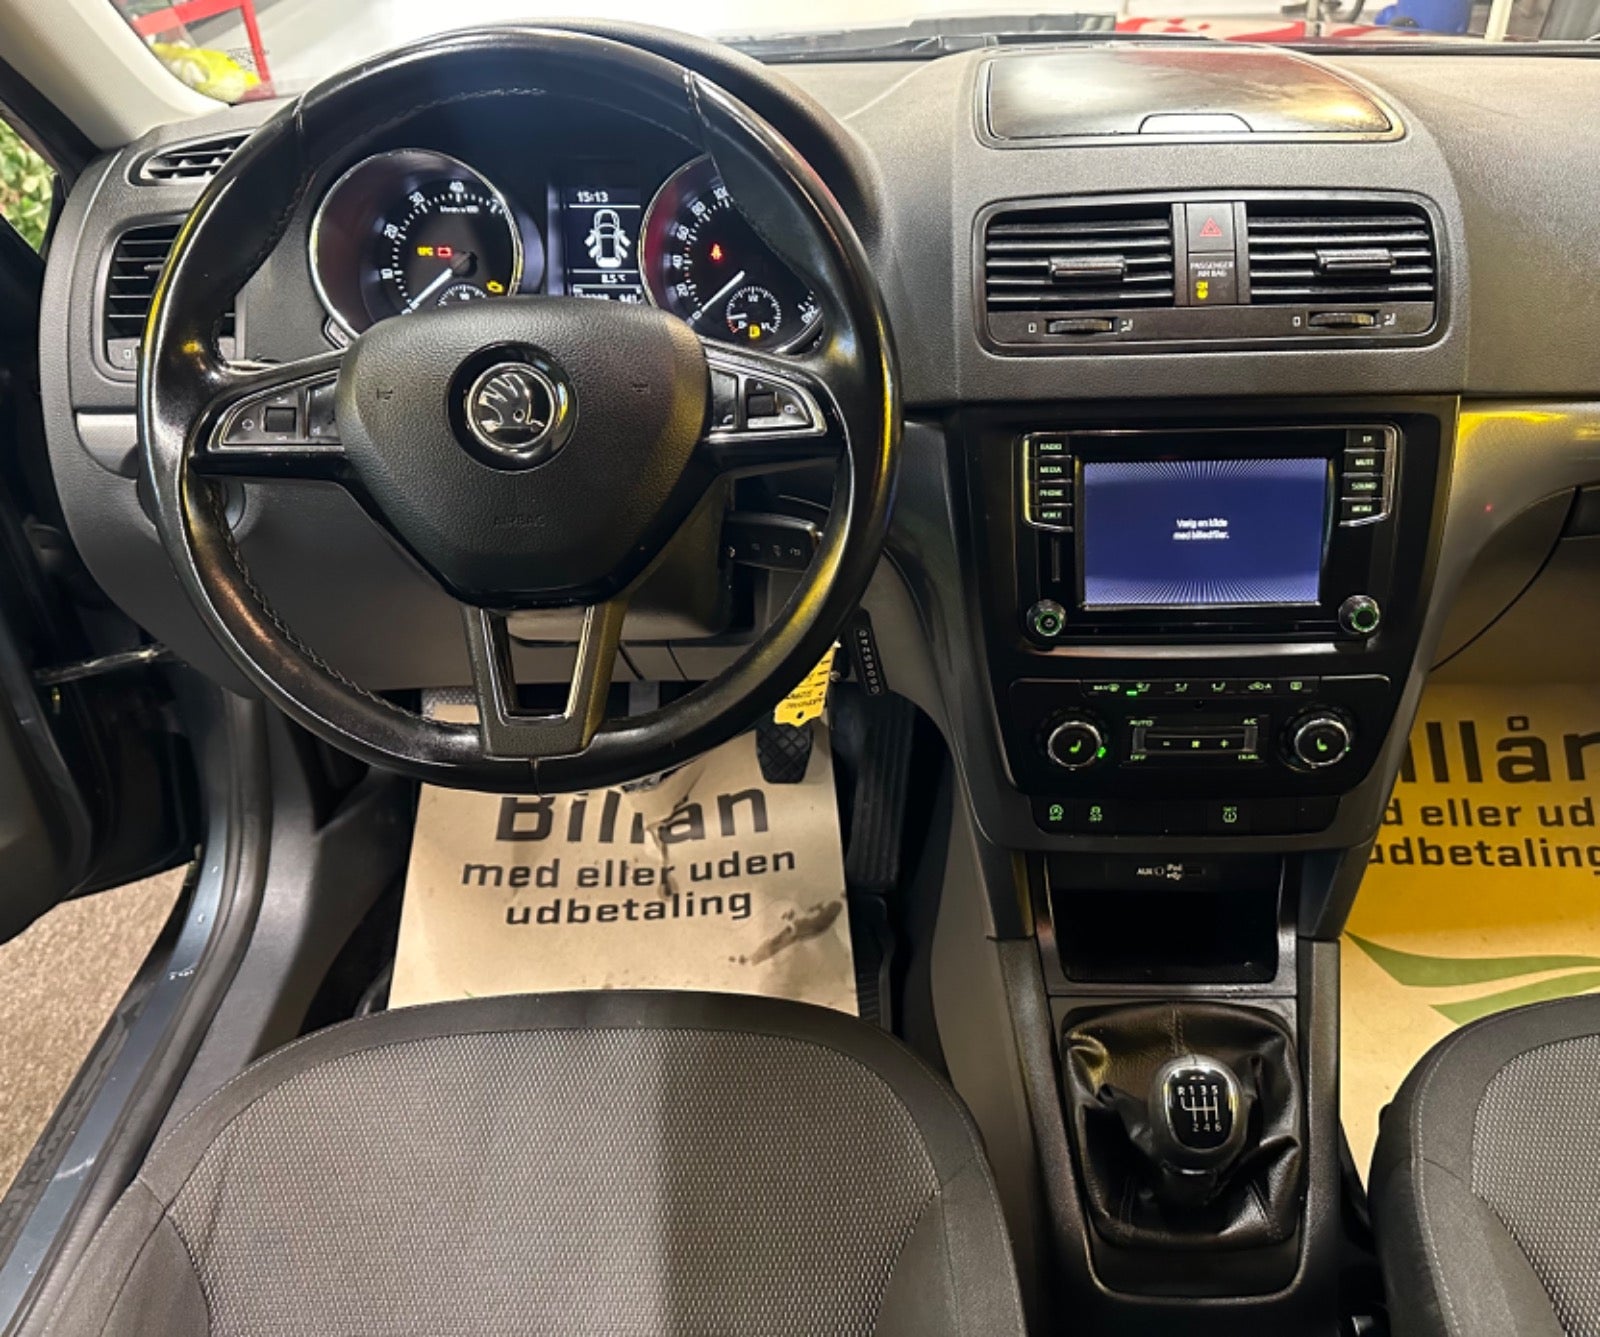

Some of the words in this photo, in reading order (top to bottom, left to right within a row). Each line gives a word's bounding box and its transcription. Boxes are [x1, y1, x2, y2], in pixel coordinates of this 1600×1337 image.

[577, 191, 609, 202] 15:13
[384, 224, 399, 239] 20
[381, 268, 394, 280] 10
[1040, 443, 1063, 451] RADIO
[1040, 466, 1063, 474] MEDIA
[1039, 489, 1065, 497] PHONE
[1129, 719, 1154, 727] AUTO
[1420, 797, 1522, 827] eller
[462, 858, 560, 889] med
[576, 859, 676, 889] eller
[690, 850, 796, 882] uden
[505, 891, 753, 926] udbetaling
